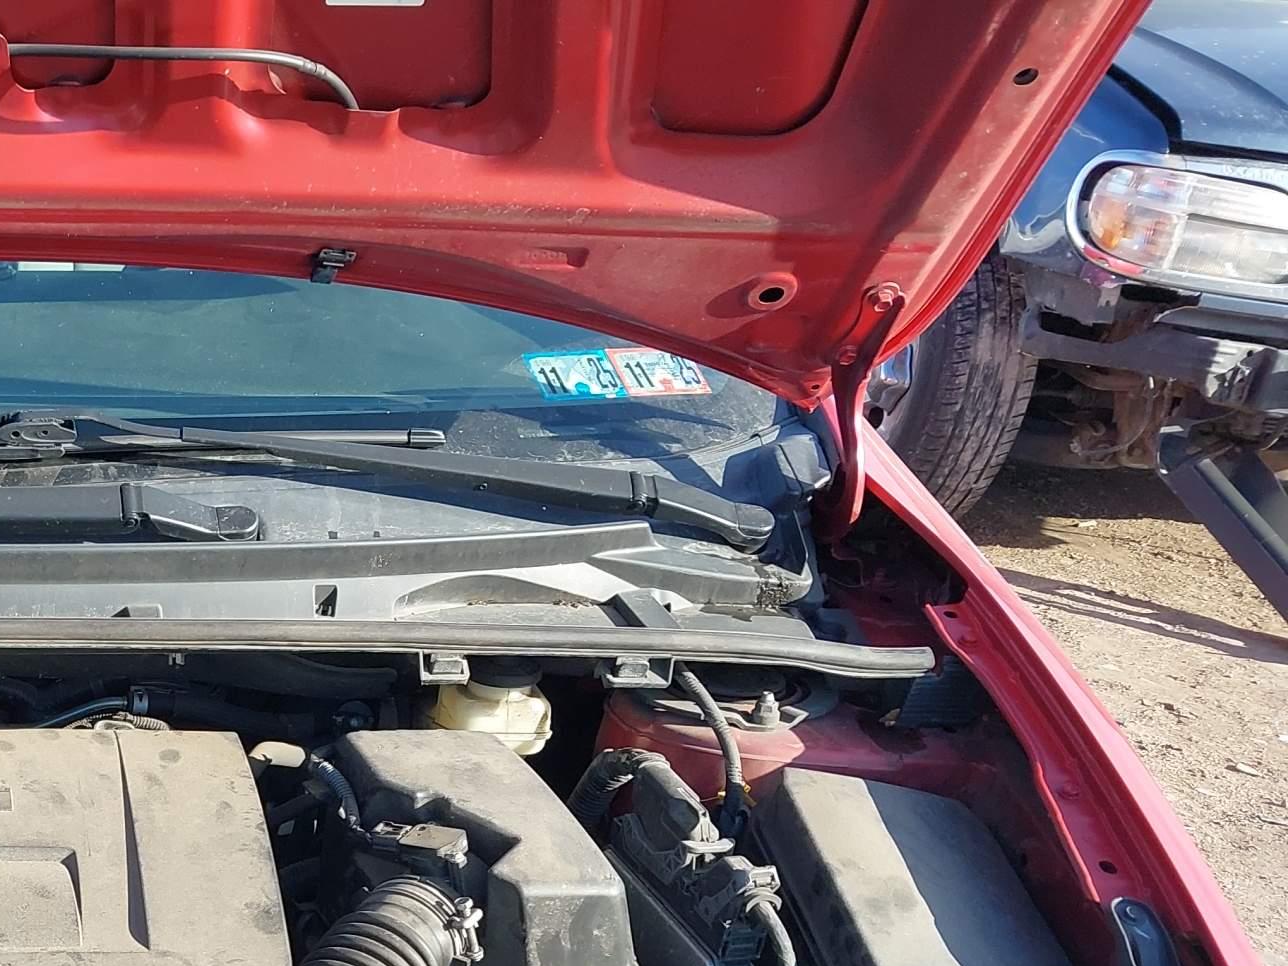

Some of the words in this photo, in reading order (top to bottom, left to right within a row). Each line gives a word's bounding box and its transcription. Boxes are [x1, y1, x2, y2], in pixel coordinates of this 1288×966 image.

[537, 366, 570, 394] 11
[587, 357, 619, 389] 25
[624, 361, 655, 388] 11
[671, 354, 701, 385] 25
